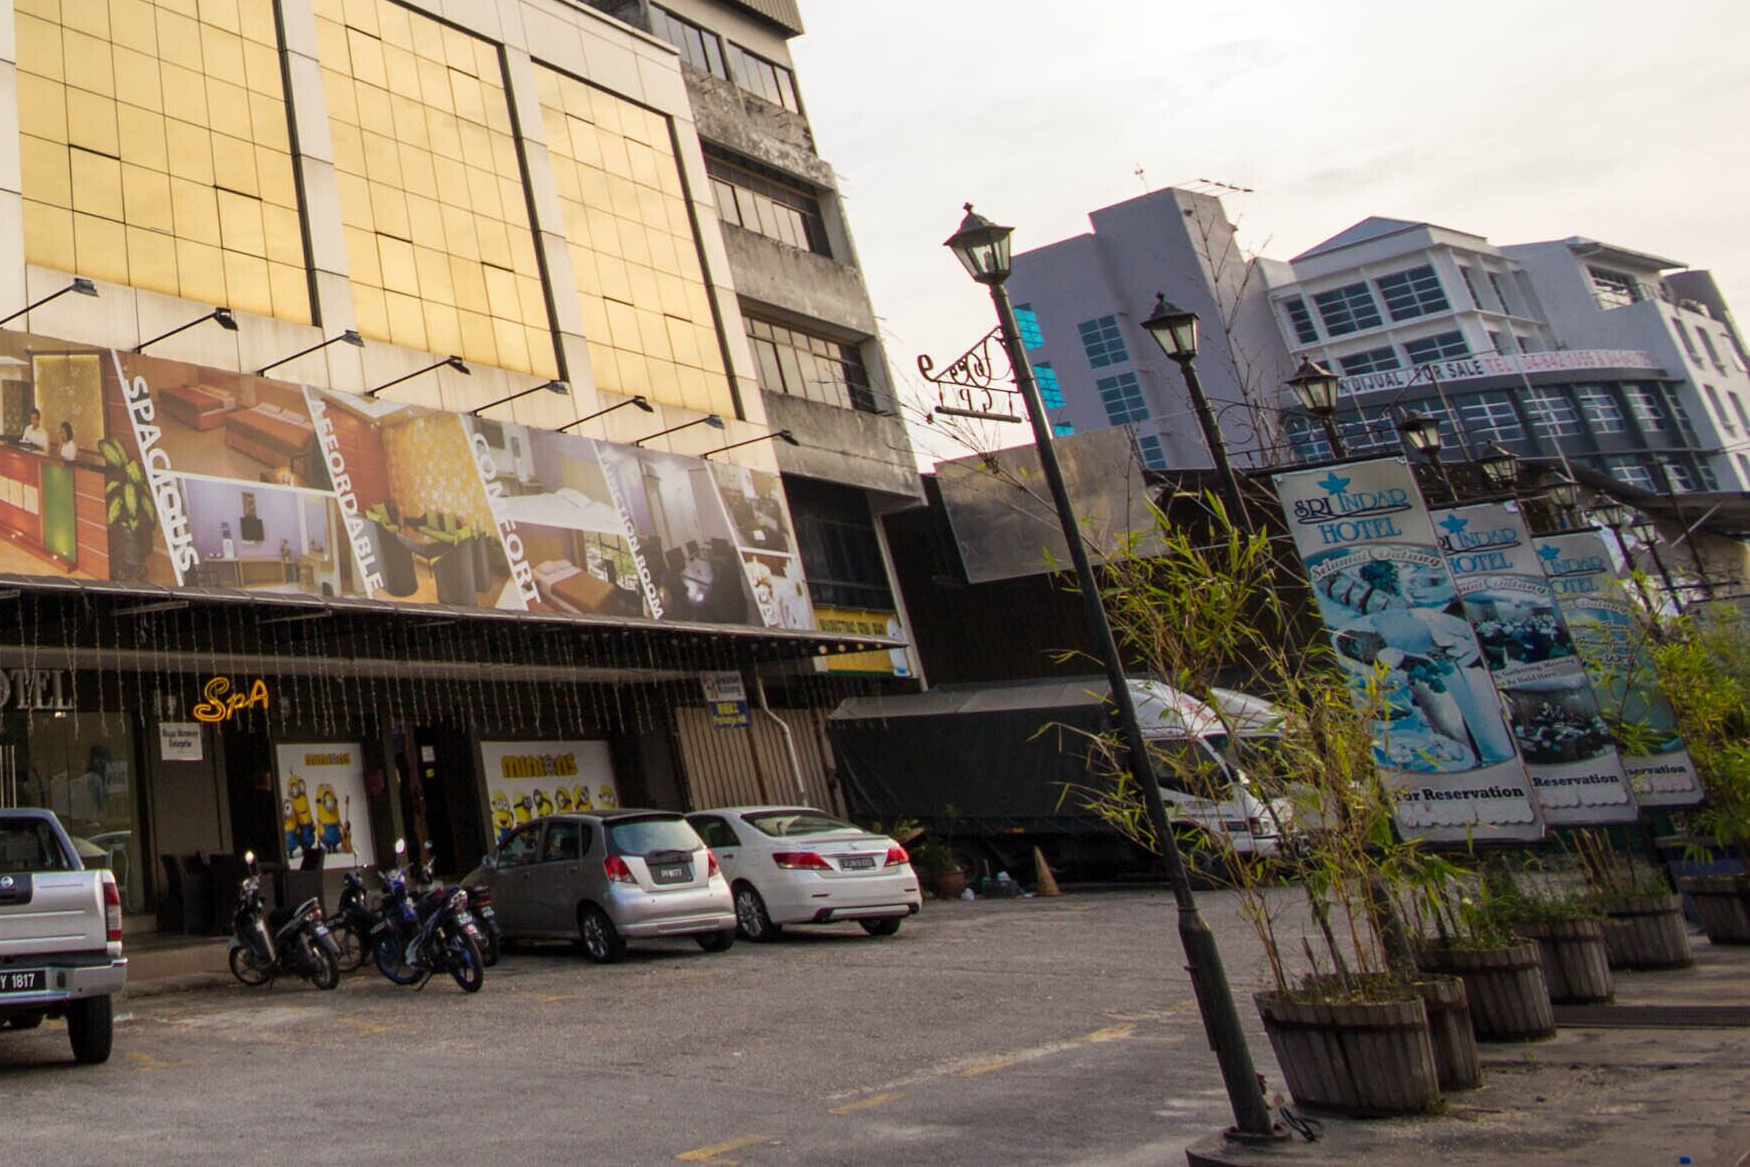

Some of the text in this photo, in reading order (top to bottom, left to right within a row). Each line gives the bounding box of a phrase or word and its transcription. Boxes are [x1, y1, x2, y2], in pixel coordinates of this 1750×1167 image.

[1351, 371, 1403, 392] DIJUAL
[1446, 360, 1485, 378] SALE
[311, 399, 384, 598] AFFORDABLE
[1294, 488, 1408, 518] SRI INDAR
[1319, 517, 1402, 545] HOTEL
[1422, 785, 1524, 801] Reservation
[1533, 773, 1619, 787] Reservation
[11, 973, 35, 989] 1817
